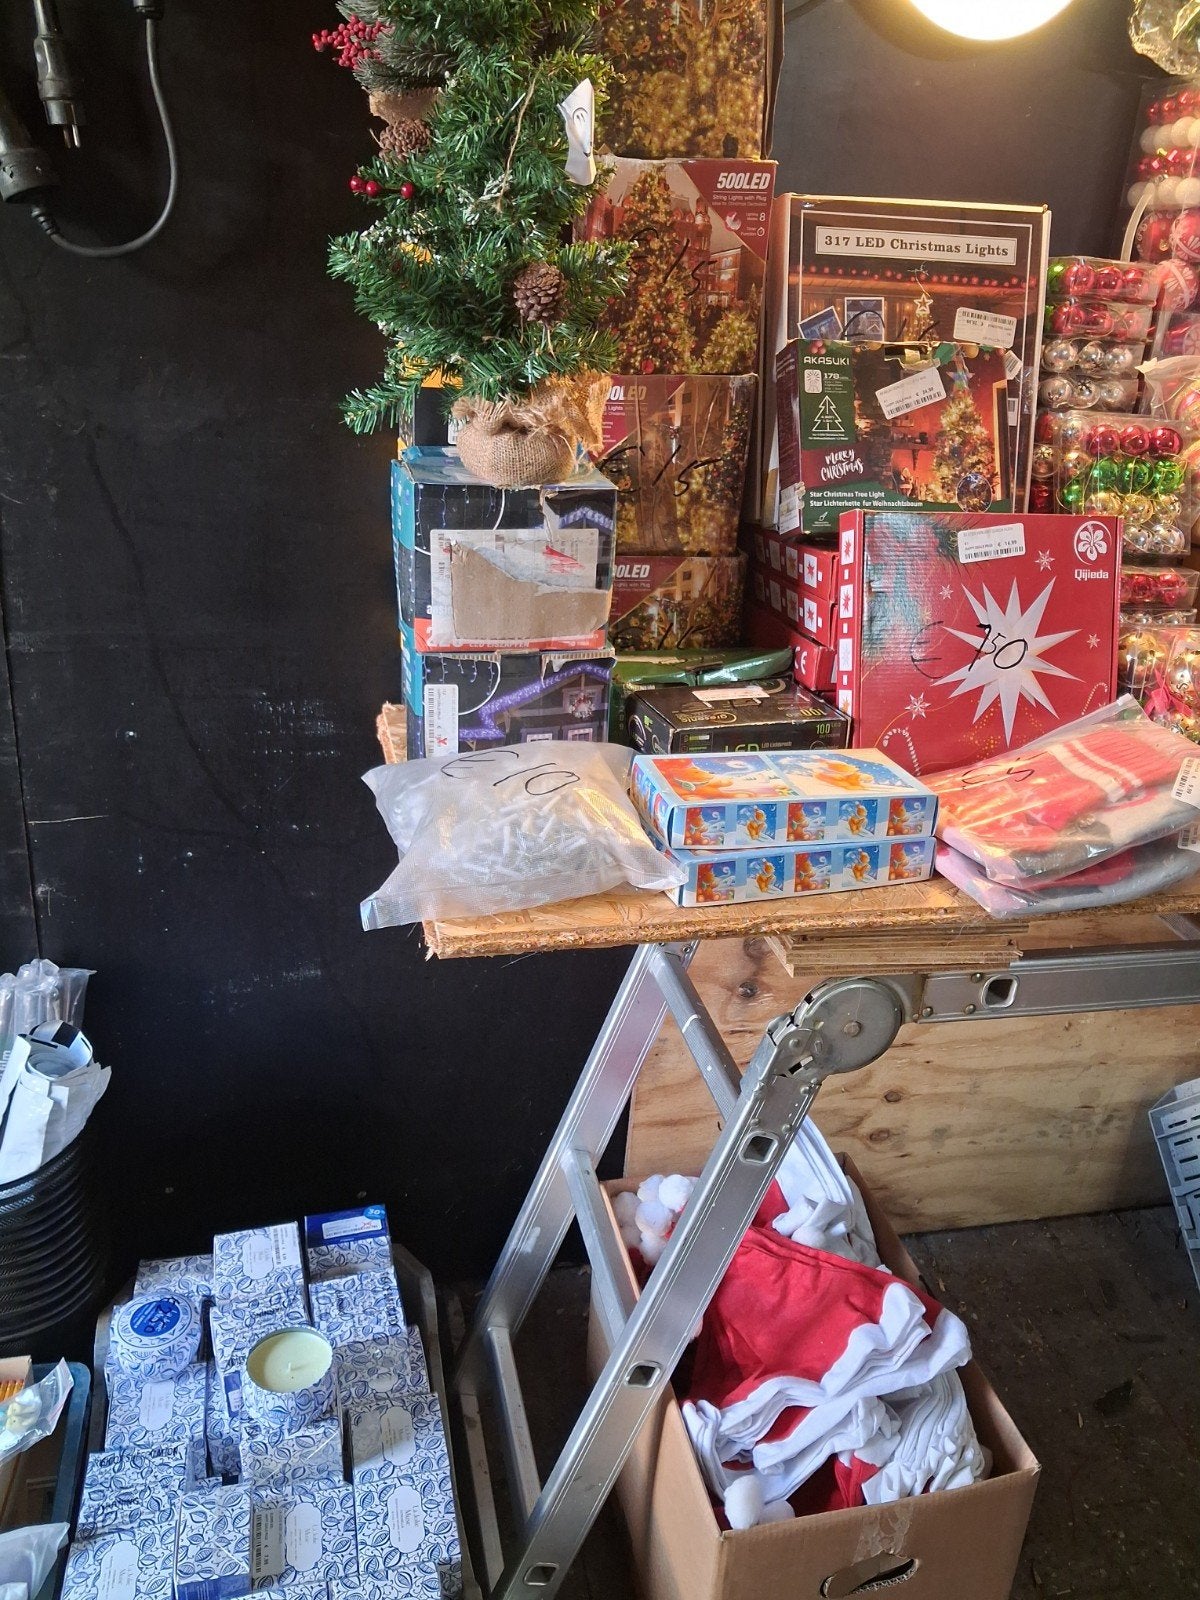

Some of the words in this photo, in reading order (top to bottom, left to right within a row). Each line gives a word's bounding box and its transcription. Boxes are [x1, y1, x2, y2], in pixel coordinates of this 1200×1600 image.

[717, 172, 771, 190] 500LED
[759, 212, 766, 221] 8
[824, 235, 850, 247] 317
[856, 236, 885, 249] LED
[890, 238, 961, 255] Christmas
[965, 243, 1009, 257] Lights
[804, 356, 850, 366] AKASUKI
[1074, 569, 1109, 579] Qijieda
[816, 723, 831, 734] 100
